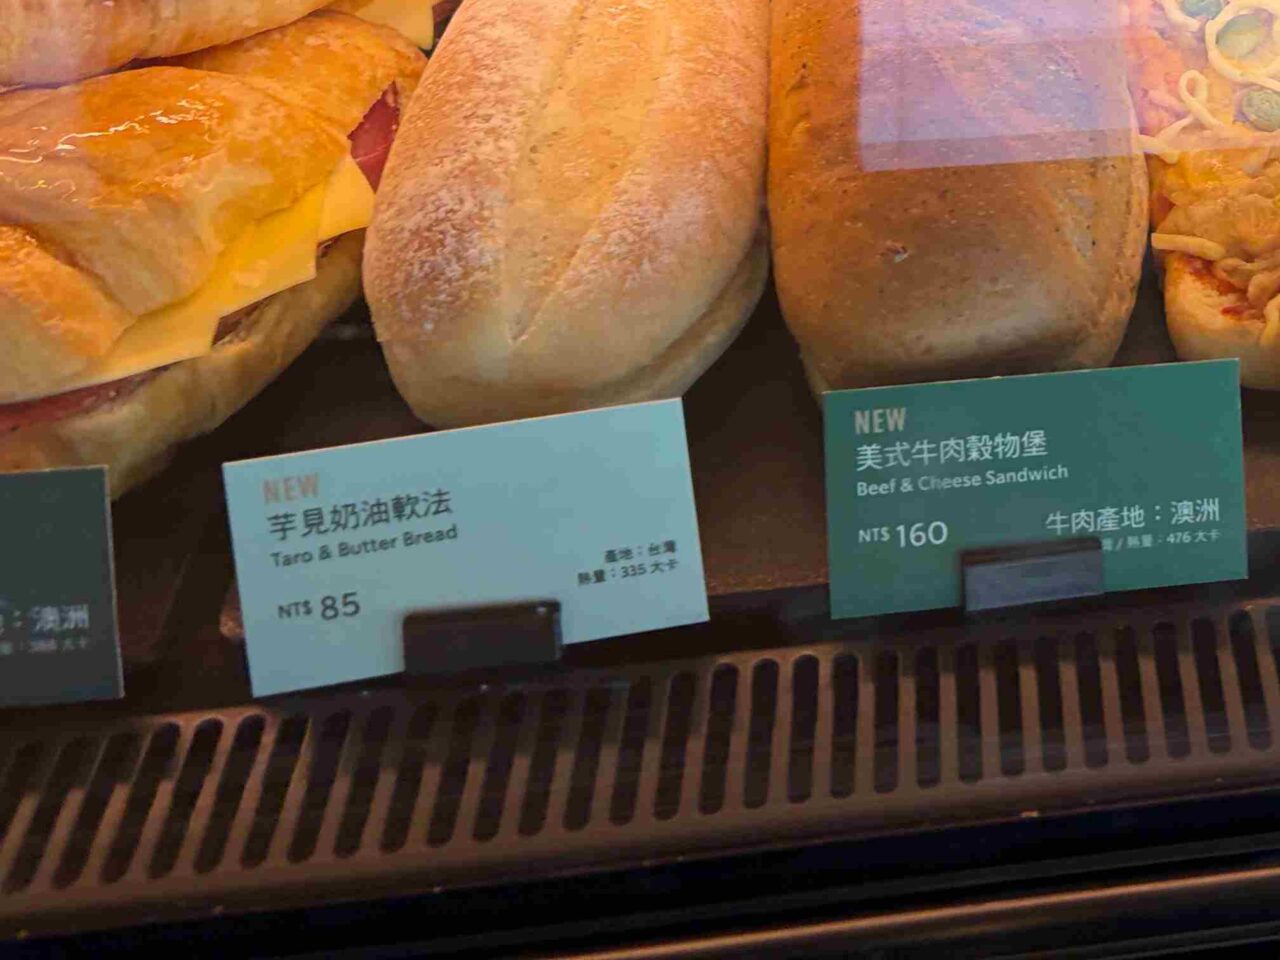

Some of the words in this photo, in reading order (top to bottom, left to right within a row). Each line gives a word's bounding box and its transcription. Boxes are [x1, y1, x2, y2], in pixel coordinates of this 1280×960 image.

[854, 407, 907, 435] NEW
[856, 430, 1049, 472] 美式牛肉穀物堡
[263, 472, 319, 503] NEW
[857, 478, 896, 496] Beef
[900, 478, 913, 493] &
[918, 473, 982, 491] Cheese
[986, 464, 1069, 486] Sandwich
[267, 488, 454, 541] 芋見奶油軟法
[1045, 497, 1220, 535] 牛肉產地：澳洲
[271, 551, 313, 567] Taro
[318, 544, 333, 561] &
[338, 536, 399, 557] Butter
[403, 524, 459, 547] Bread
[858, 526, 890, 543] NT$
[896, 520, 948, 548] 160
[278, 600, 313, 619] NT$
[320, 592, 361, 621] 85
